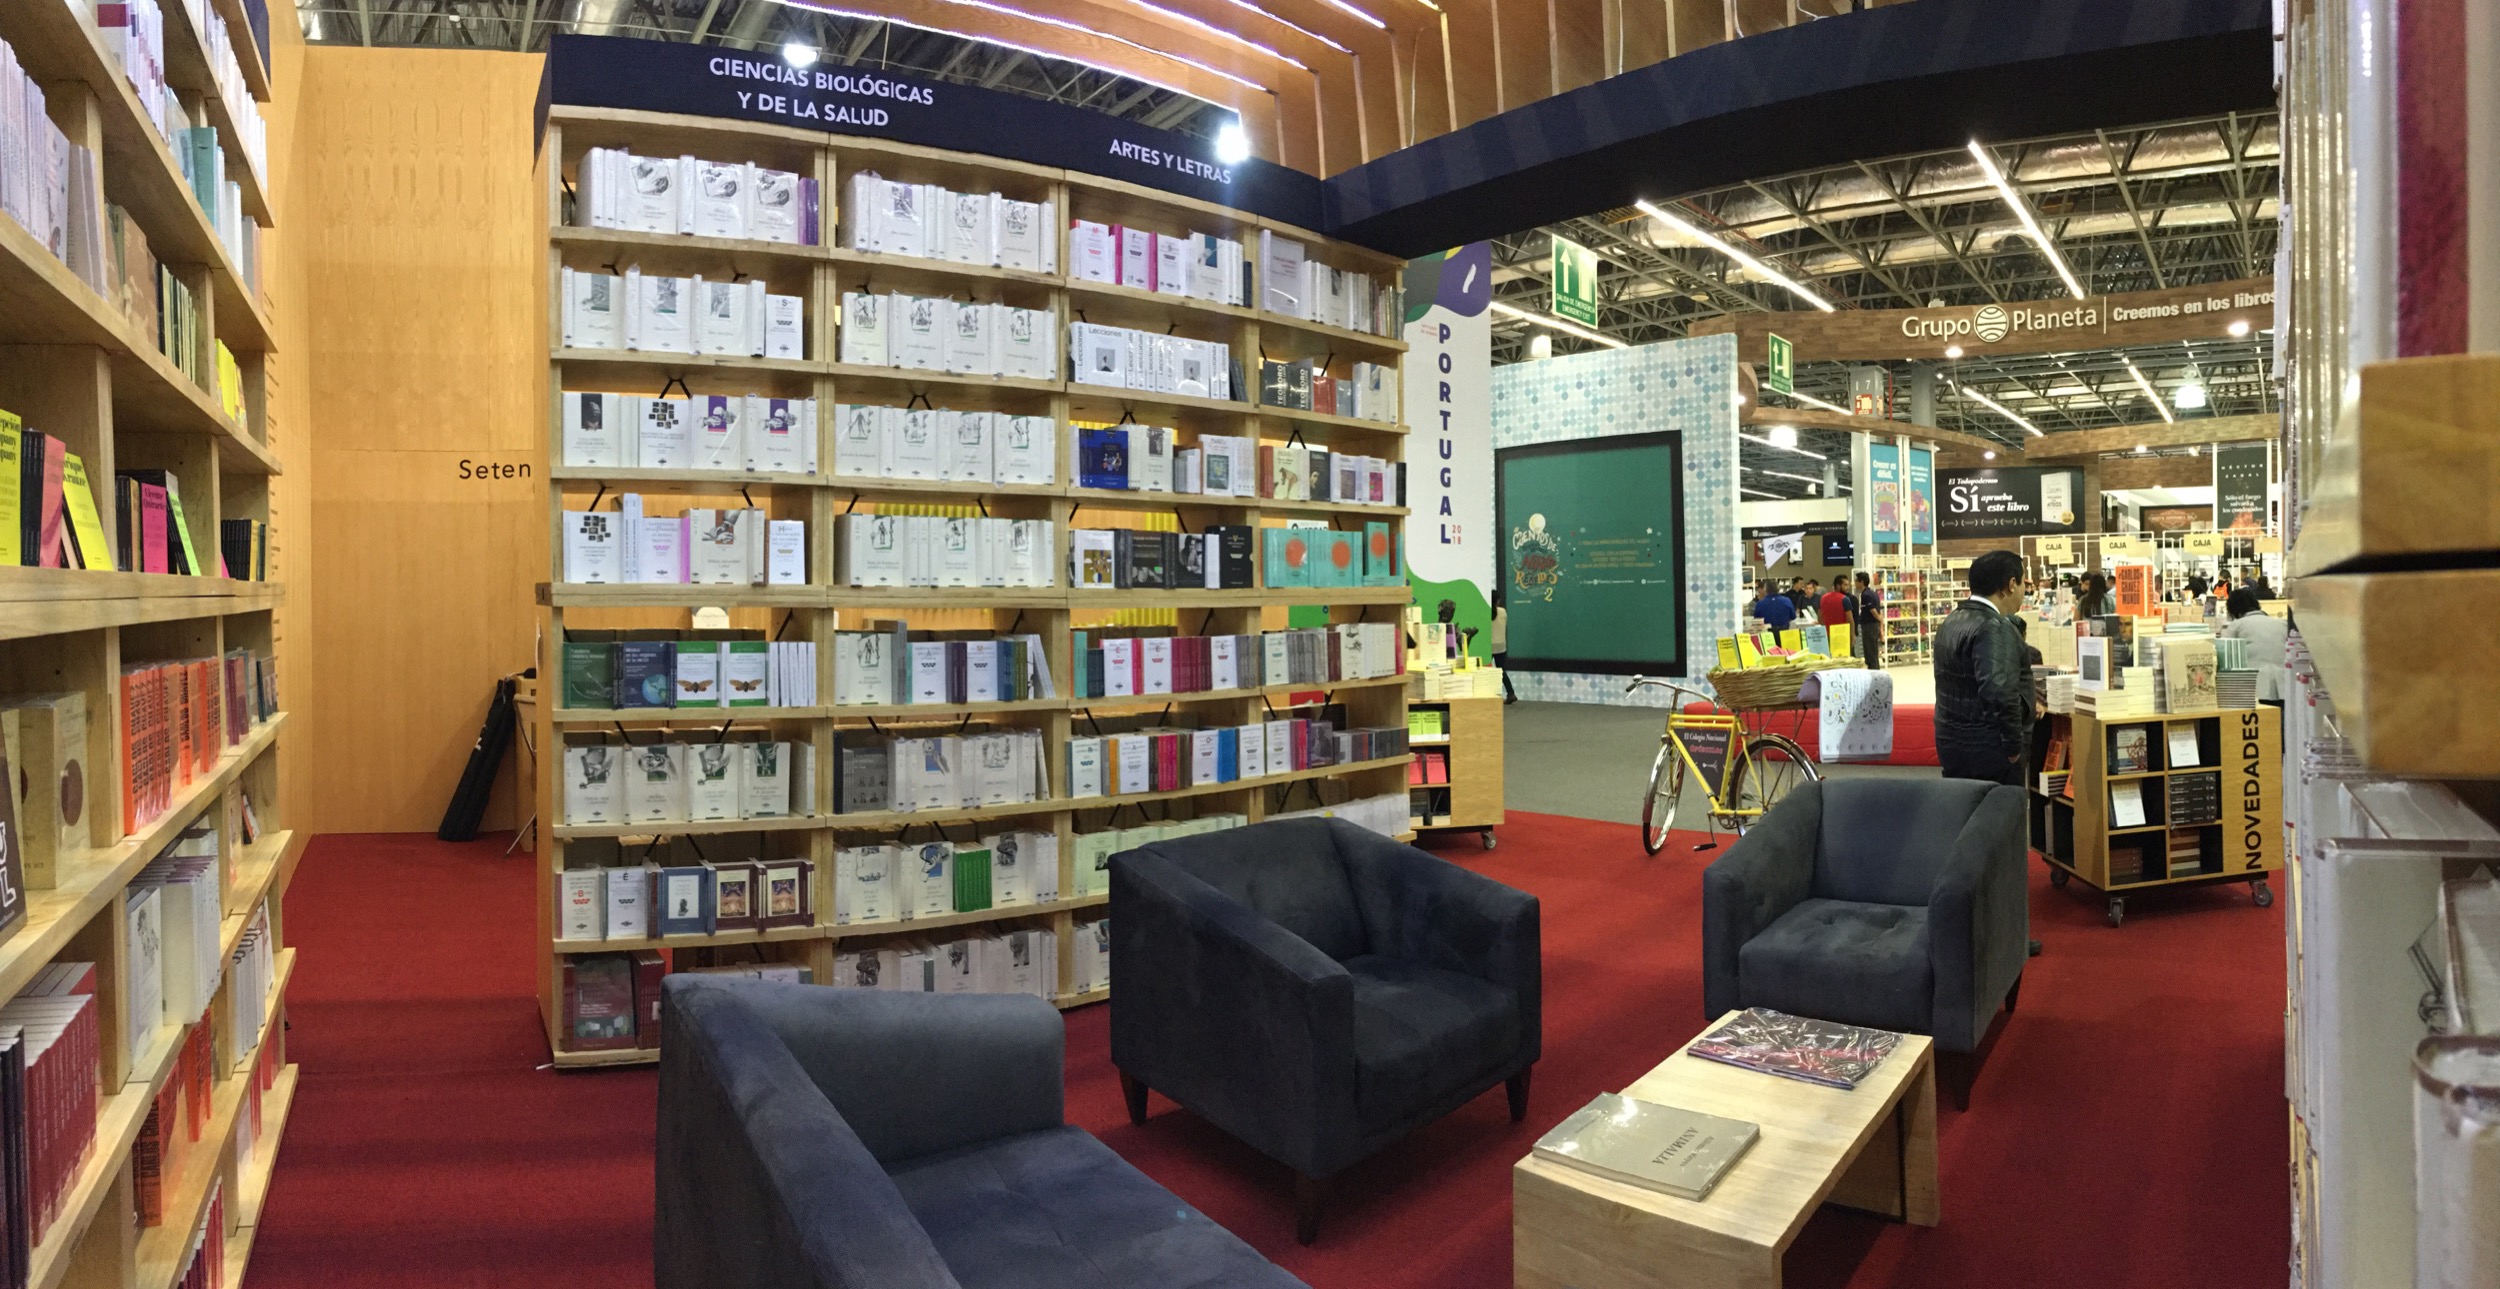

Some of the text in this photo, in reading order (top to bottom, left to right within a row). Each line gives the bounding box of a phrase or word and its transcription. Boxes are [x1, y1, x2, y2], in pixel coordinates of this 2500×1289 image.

[709, 57, 934, 105] CIENCIAS BIOLÓGICAS
[737, 91, 889, 126] Y DE LA SALUD
[1109, 139, 1232, 185] ARTES Y LETRAS
[2113, 304, 2179, 322] Creemos
[2184, 302, 2202, 314] en
[2206, 297, 2230, 312] los
[1088, 326, 1122, 338] Lecciones
[1902, 305, 2097, 342] Grupo Planeta
[1438, 322, 1452, 545] PORTUGAL
[459, 459, 531, 480] Seten
[1950, 485, 1981, 513] Sí
[1981, 492, 2013, 504] aprueba
[1987, 500, 2030, 513] este libro
[2045, 543, 2062, 551] CAJA
[2109, 541, 2127, 550] CAJA
[2193, 539, 2211, 548] CAJA
[1544, 586, 1553, 602] 2
[2241, 712, 2262, 870] NOVEDADES
